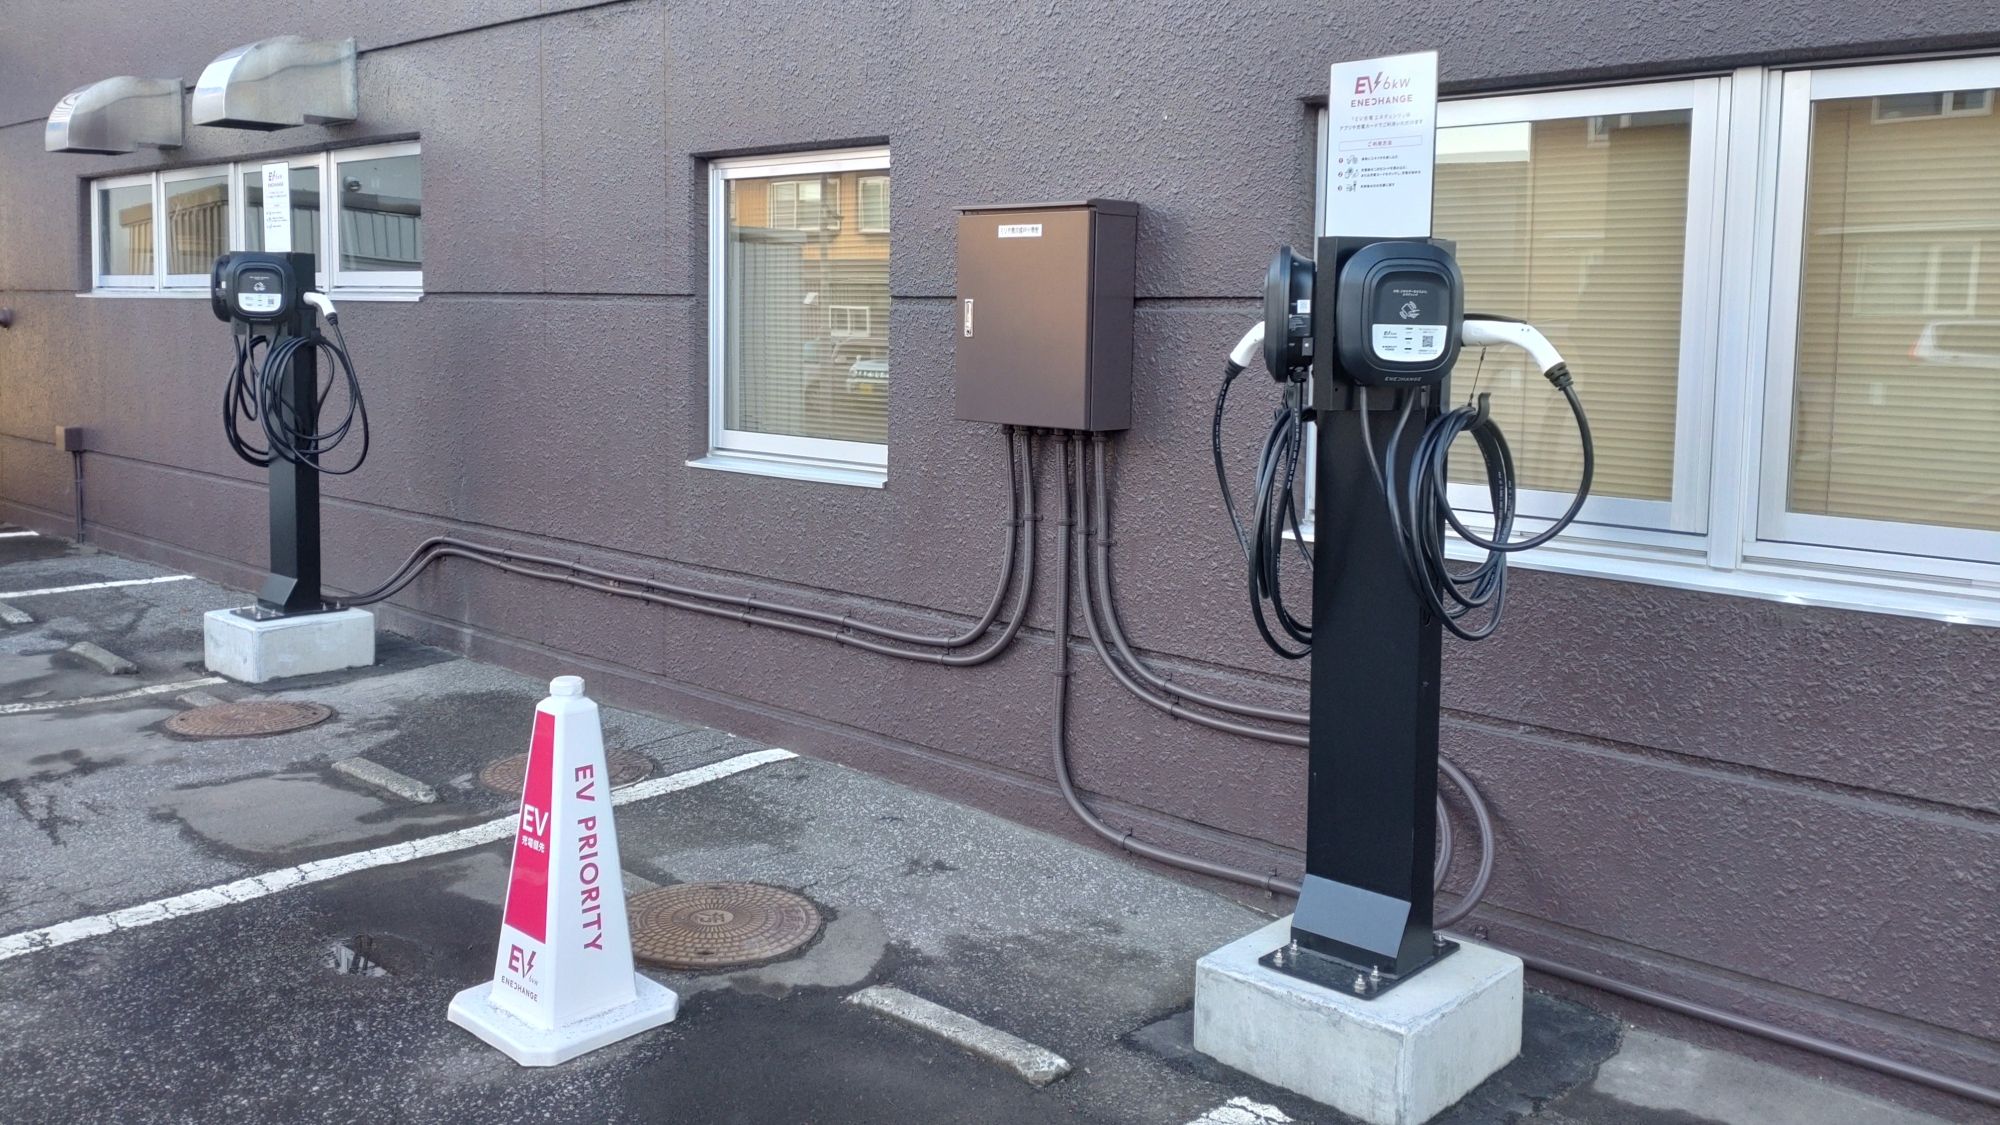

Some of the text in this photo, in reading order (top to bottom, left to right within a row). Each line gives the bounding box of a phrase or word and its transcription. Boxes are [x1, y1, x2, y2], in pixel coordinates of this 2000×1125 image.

[1355, 72, 1410, 94] EV 6kW
[523, 804, 549, 837] EV
[574, 764, 603, 951] EV PRIORITY
[508, 944, 537, 979] EV
